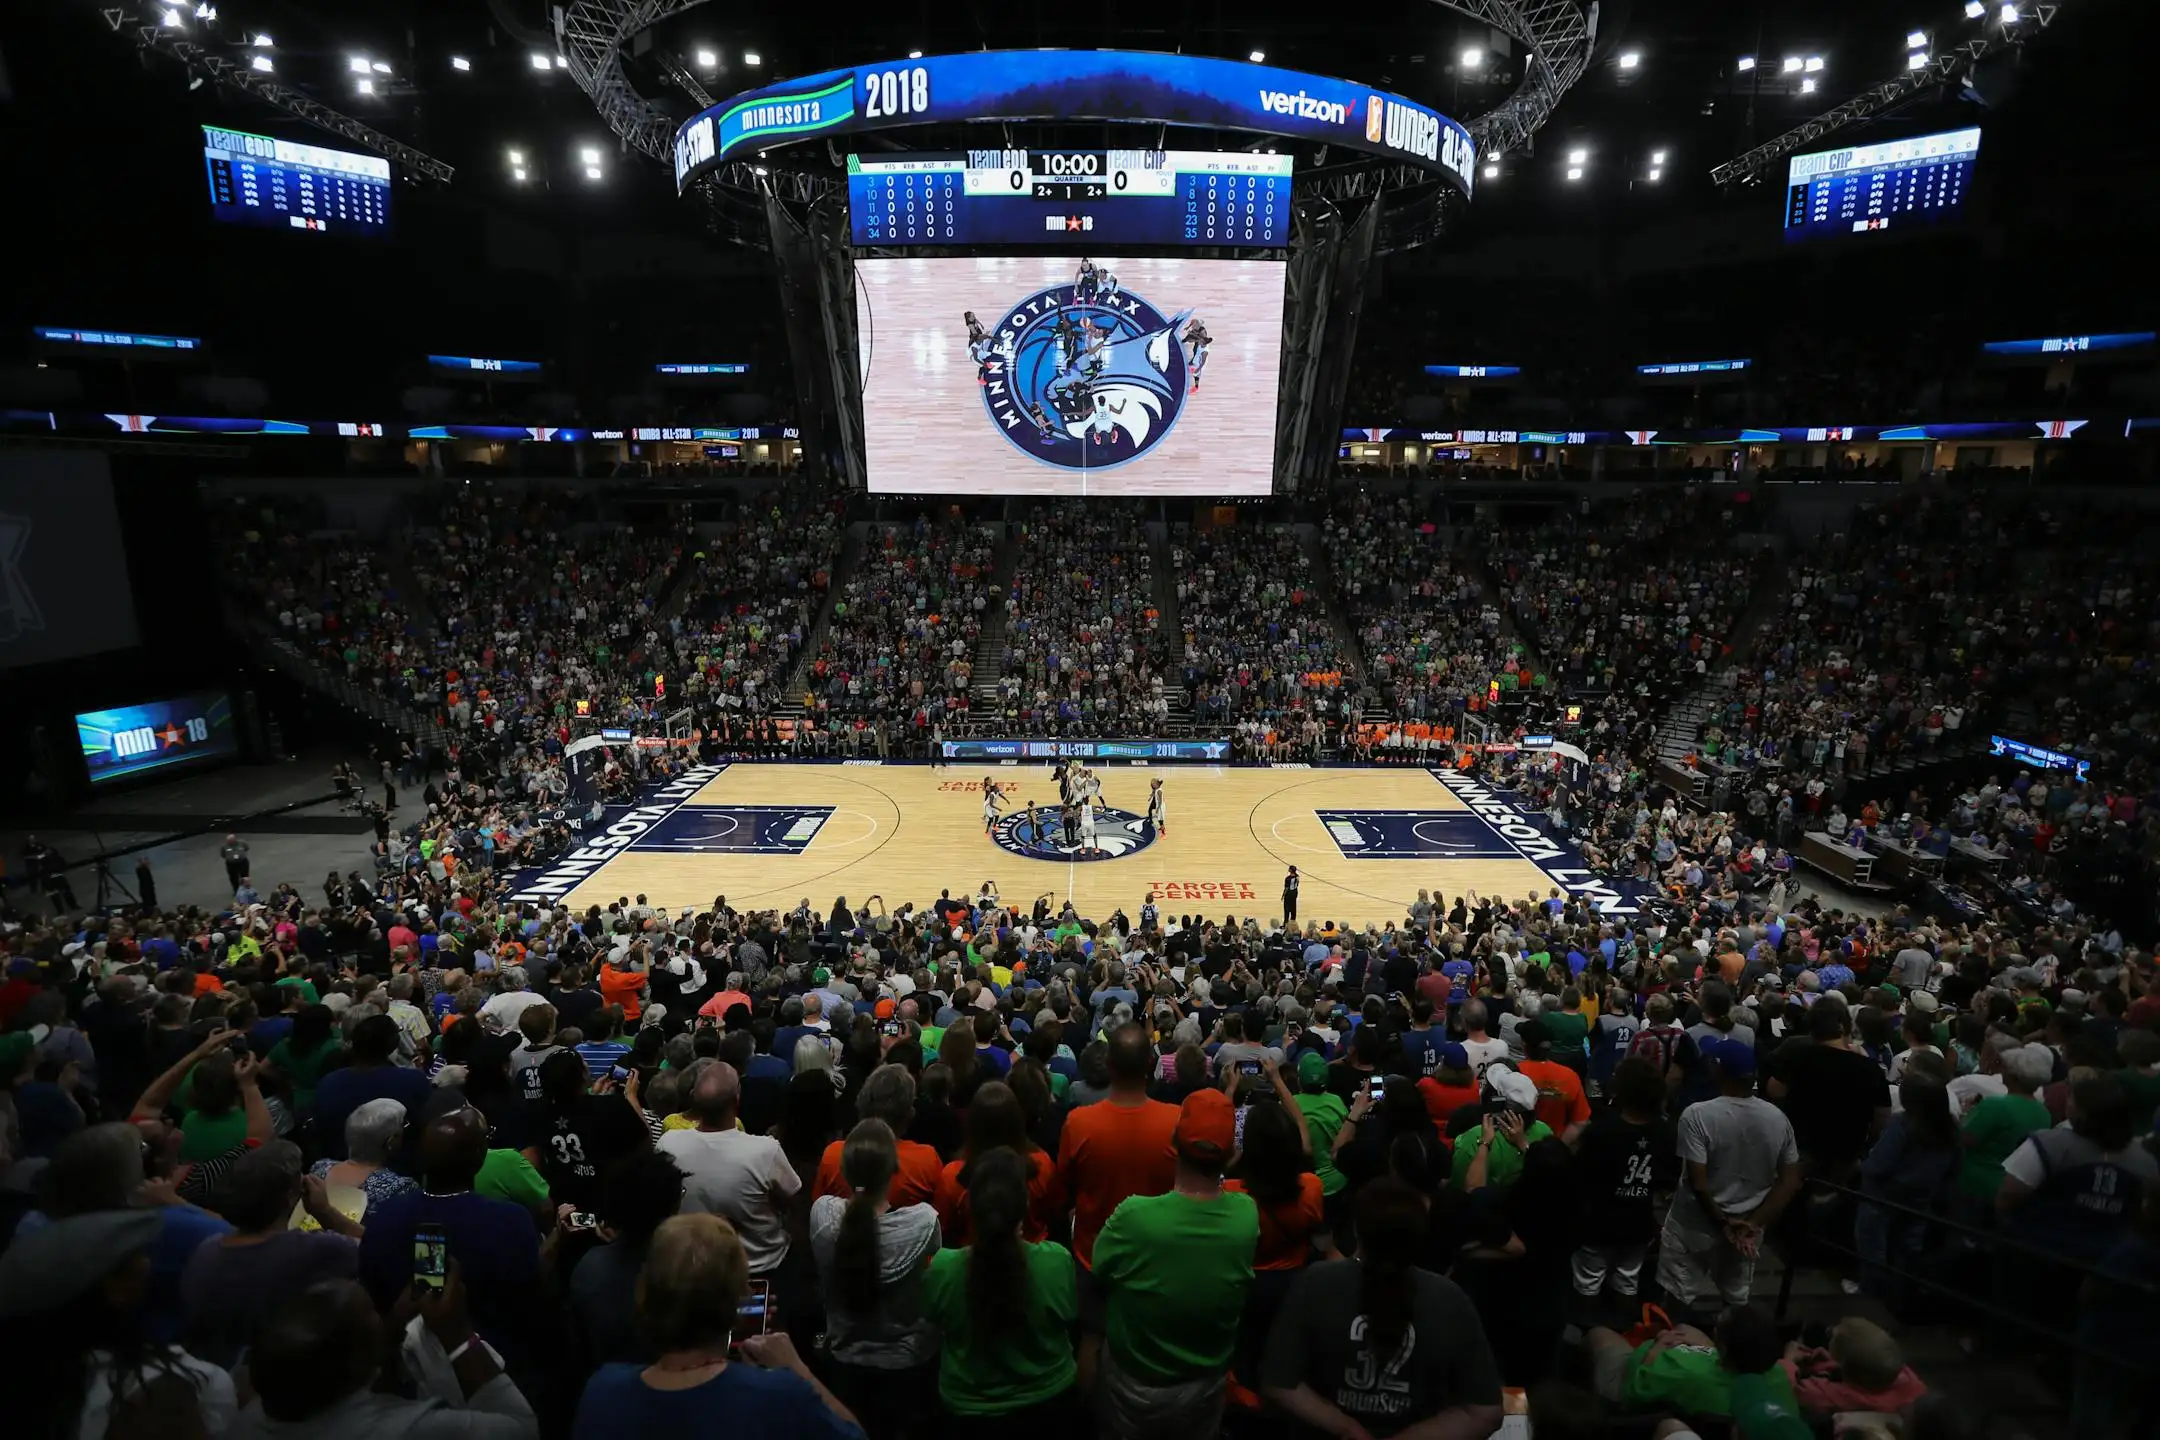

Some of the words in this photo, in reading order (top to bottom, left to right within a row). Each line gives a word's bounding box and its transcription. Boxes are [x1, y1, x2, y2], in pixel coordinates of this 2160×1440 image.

[866, 68, 928, 118] 2018
[1260, 90, 1346, 125] verizon
[1385, 101, 1439, 162] WNBA
[1042, 154, 1098, 175] 10:00
[887, 176, 894, 186] 0
[906, 175, 913, 186] 0
[925, 175, 932, 185] 0
[945, 175, 952, 185] 0
[1010, 170, 1023, 190] 0
[1114, 170, 1128, 190] 0
[1209, 176, 1216, 186] 0
[1229, 177, 1235, 187] 0
[1248, 177, 1255, 188] 0
[1268, 178, 1274, 188] 0
[867, 190, 877, 200] 10
[888, 189, 895, 199] 0
[906, 188, 913, 199] 0
[925, 188, 932, 198] 0
[945, 188, 952, 198] 0
[1066, 187, 1071, 199] 1
[1208, 189, 1215, 199] 0
[1228, 190, 1234, 200] 0
[1247, 190, 1254, 201] 0
[1267, 191, 1273, 201] 0
[888, 202, 895, 212] 0
[907, 201, 914, 212] 0
[926, 201, 933, 211] 0
[946, 201, 953, 211] 0
[1187, 202, 1197, 212] 12
[1208, 202, 1215, 212] 0
[1228, 203, 1234, 213] 0
[1247, 203, 1254, 214] 0
[1267, 204, 1273, 214] 0
[867, 215, 880, 226] 30
[889, 215, 896, 225] 0
[908, 214, 915, 225] 0
[927, 214, 934, 224] 0
[946, 214, 953, 224] 0
[1185, 215, 1198, 225] 23
[1207, 215, 1214, 225] 0
[1227, 216, 1233, 226] 0
[1246, 216, 1253, 227] 0
[1266, 217, 1272, 227] 0
[868, 228, 880, 238] 34
[889, 227, 896, 237] 0
[908, 226, 915, 237] 0
[927, 226, 934, 236] 0
[946, 226, 953, 236] 0
[1185, 228, 1197, 238] 35
[1206, 228, 1213, 238] 0
[1226, 229, 1232, 239] 0
[1245, 229, 1252, 240] 0
[1265, 230, 1271, 240] 0
[988, 296, 1058, 430] MINNESOTA
[592, 431, 623, 439] verizon
[742, 428, 760, 439] 2018
[1421, 431, 1453, 440] verizon
[1568, 432, 1586, 444] 2018
[114, 727, 158, 757] min
[185, 717, 209, 742] 18
[985, 743, 1016, 753] verizon
[1059, 742, 1094, 757] ALL-STAR
[1156, 743, 1177, 757] 2018
[1430, 768, 1567, 861] MINNESOTA
[503, 803, 677, 908] INNESOTA
[653, 763, 729, 799] LYNX
[1147, 882, 1252, 891] TARGET
[1150, 891, 1257, 899] CENTER
[1618, 1029, 1630, 1041] 23
[1424, 1050, 1436, 1064] 13
[551, 1133, 585, 1164] 33
[1624, 1154, 1652, 1185] 34
[1344, 1314, 1416, 1393] 32
